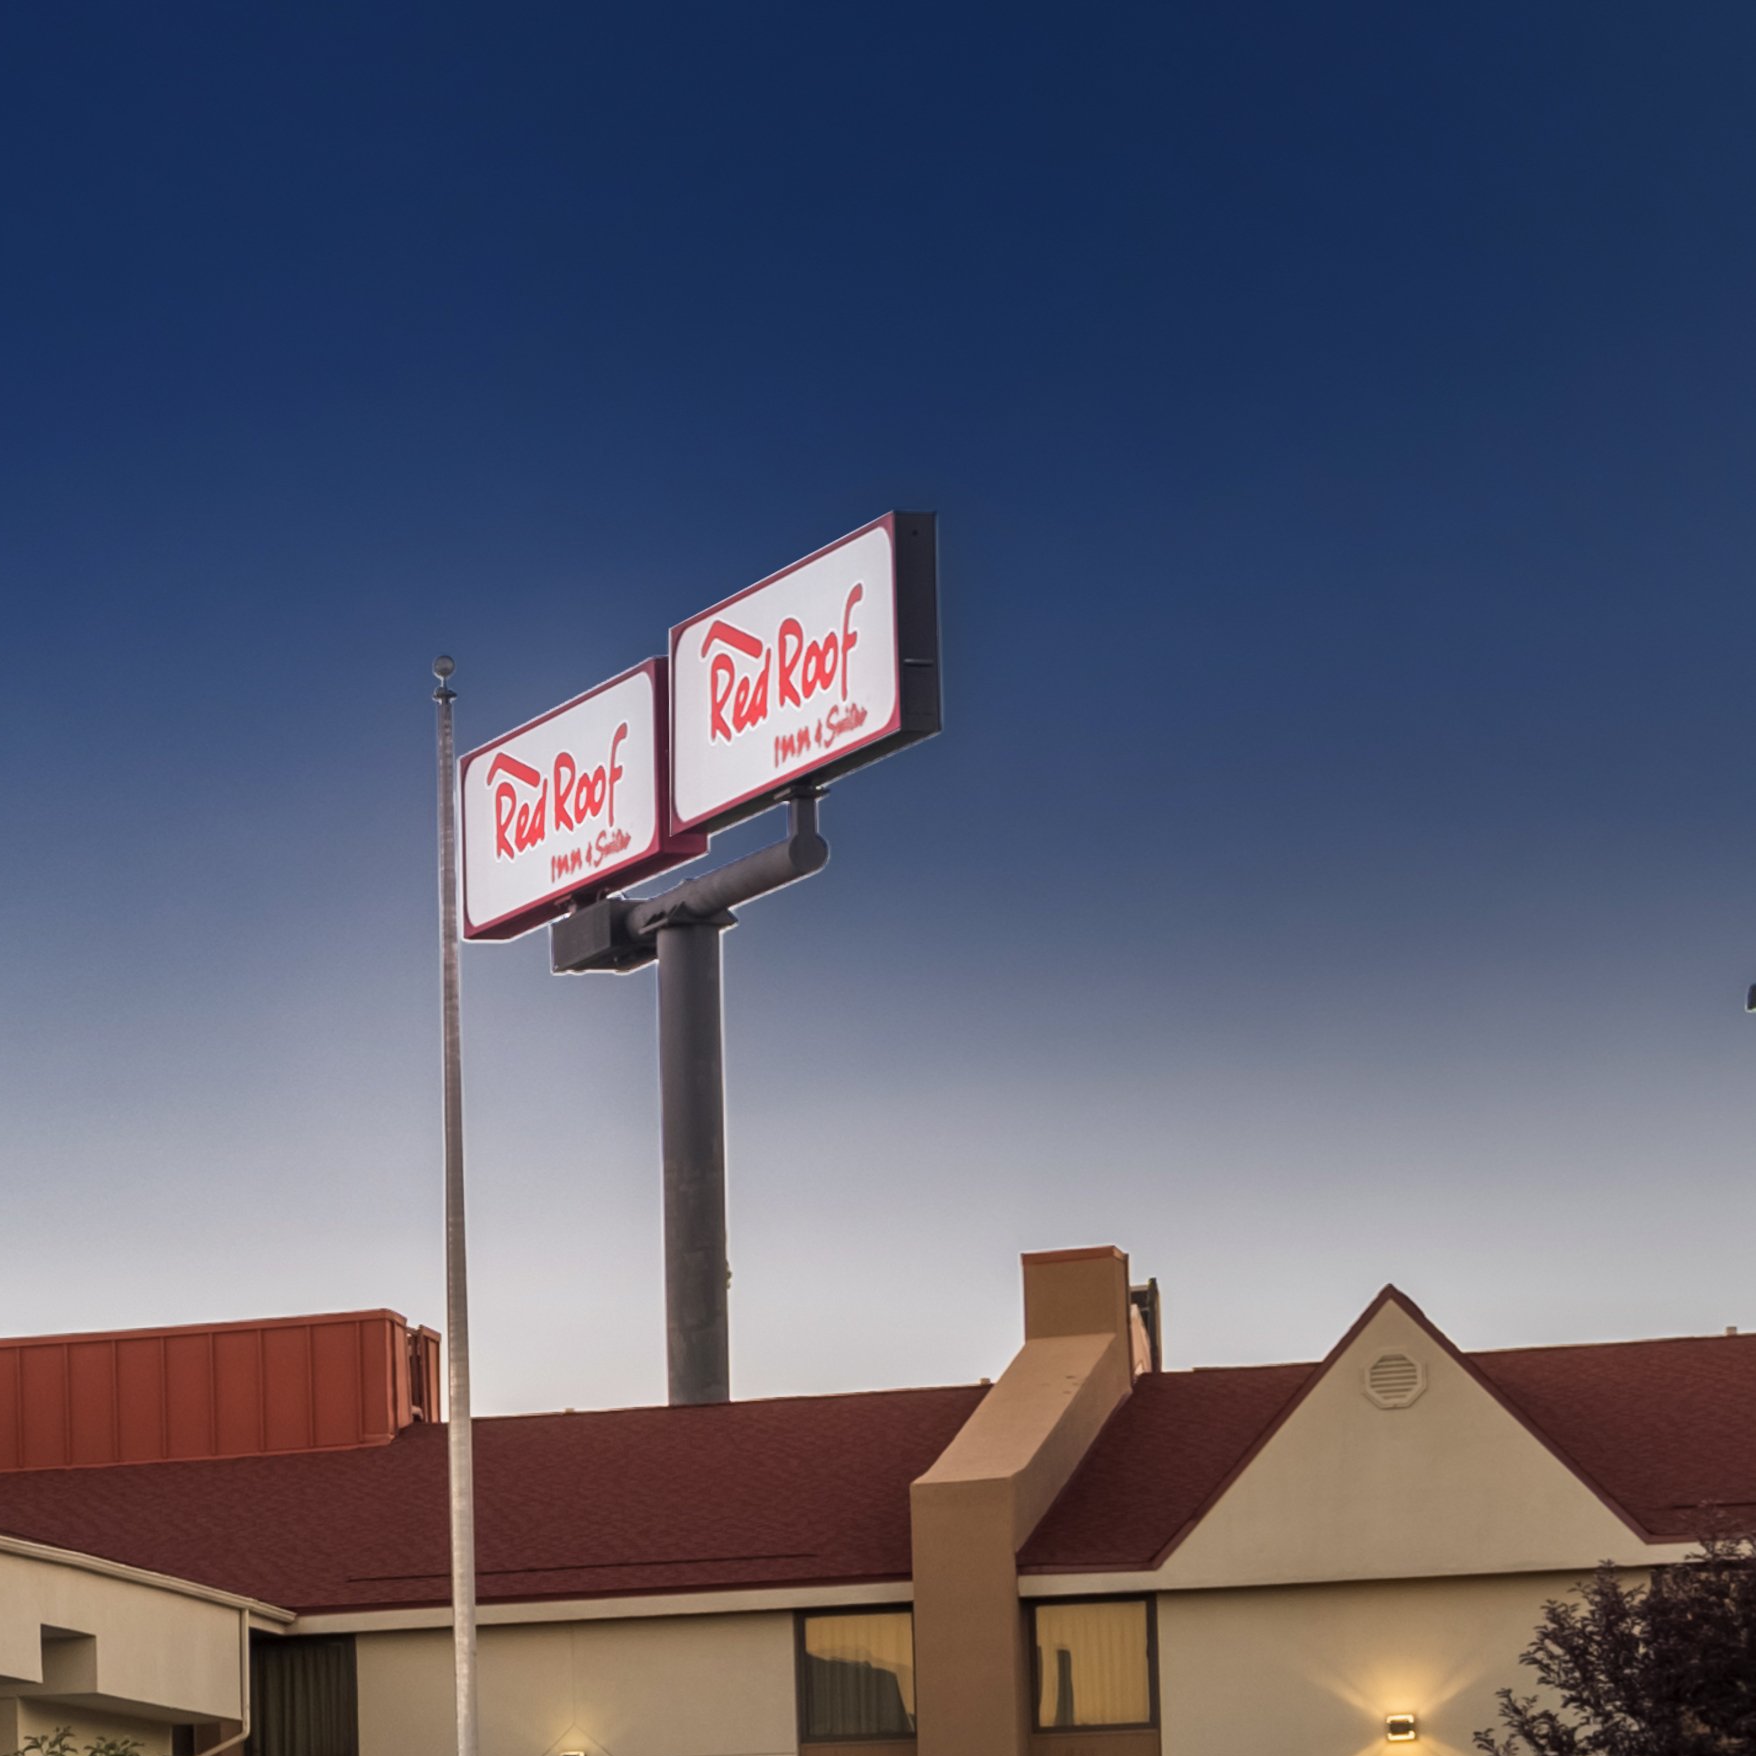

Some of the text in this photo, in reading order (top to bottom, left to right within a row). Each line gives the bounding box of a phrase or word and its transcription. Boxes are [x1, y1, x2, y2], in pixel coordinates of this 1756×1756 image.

[710, 585, 862, 741] Red Roof
[495, 724, 627, 859] Red Roof
